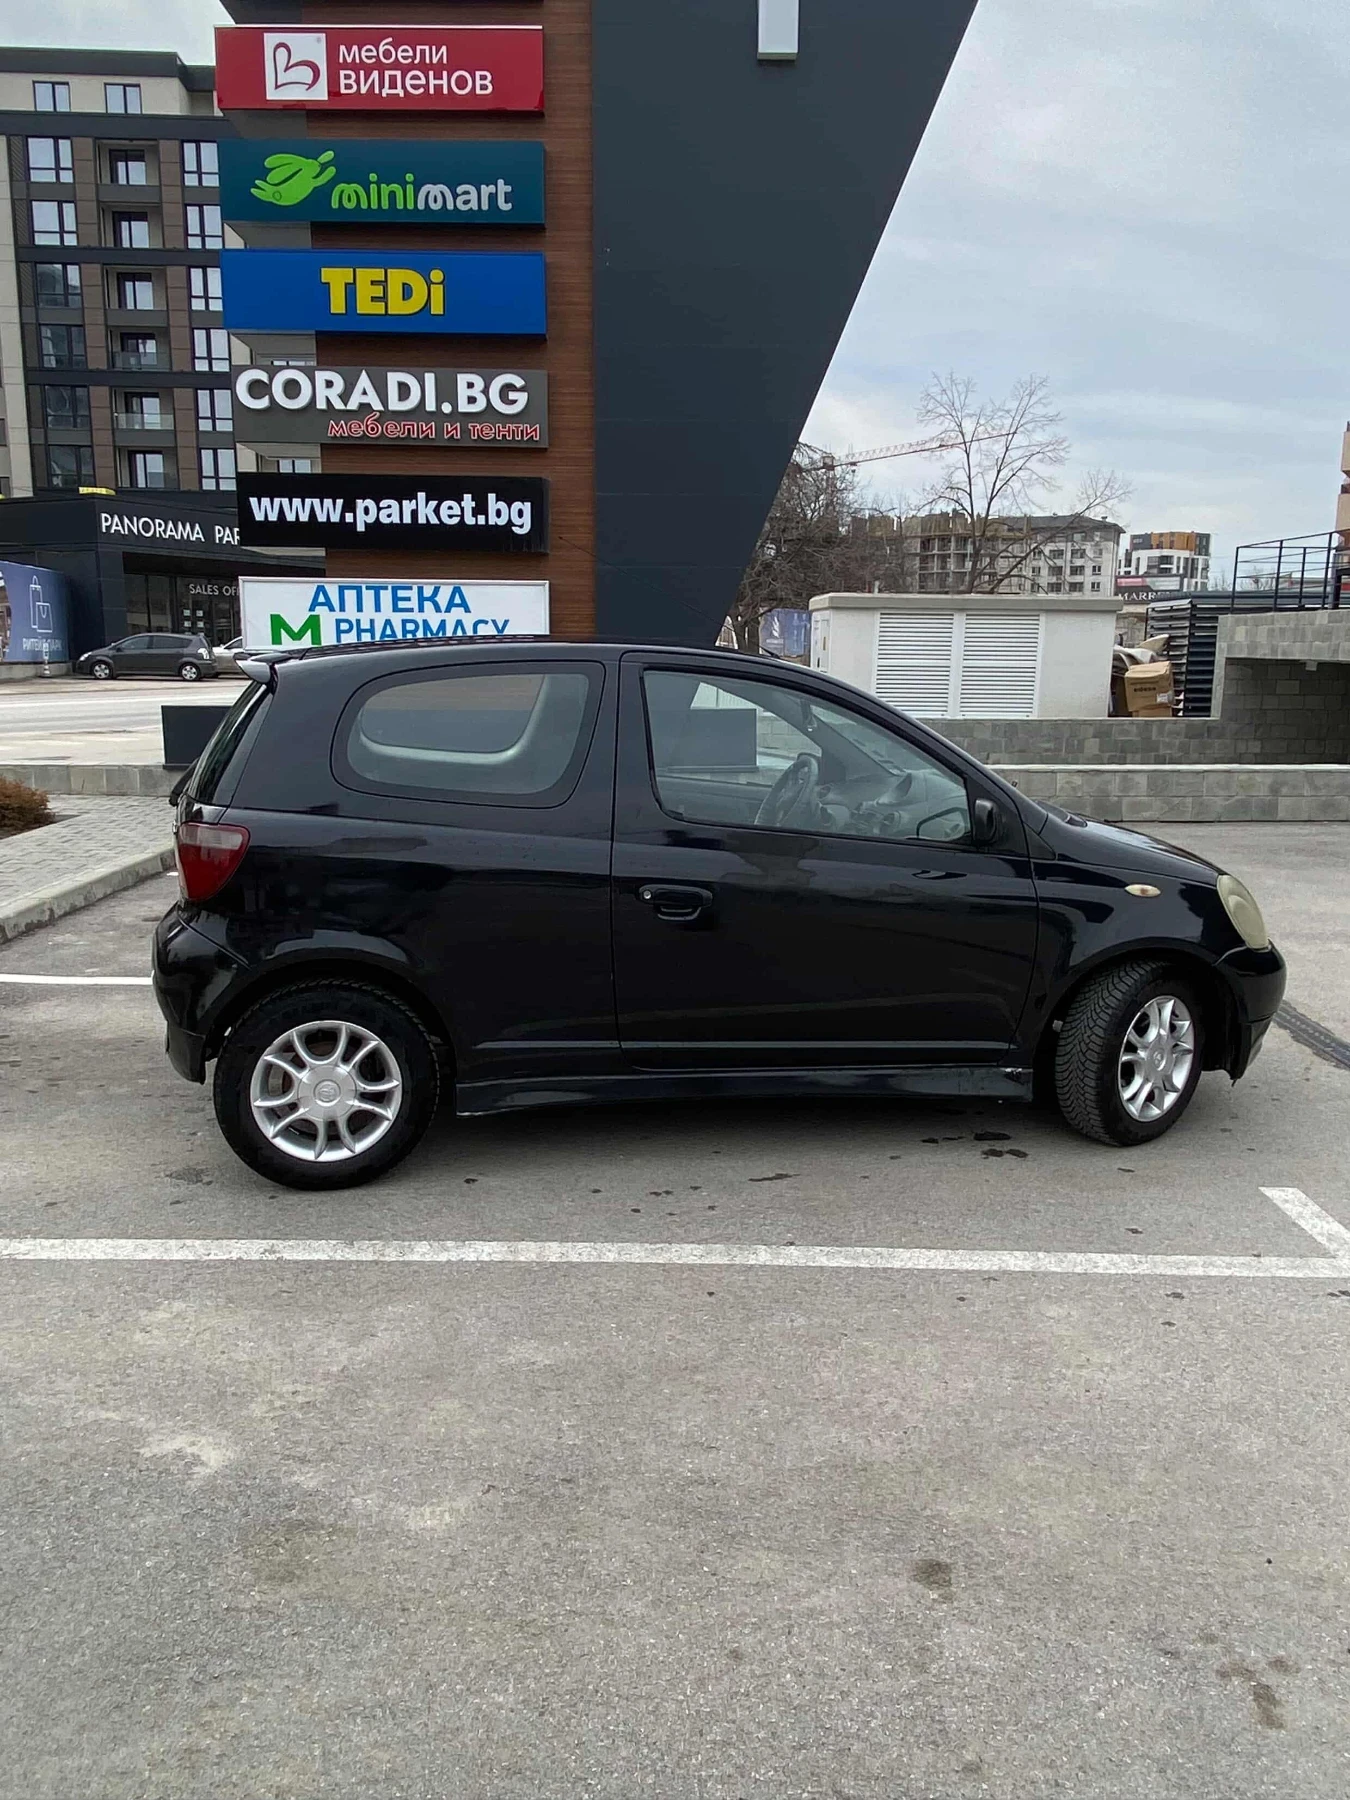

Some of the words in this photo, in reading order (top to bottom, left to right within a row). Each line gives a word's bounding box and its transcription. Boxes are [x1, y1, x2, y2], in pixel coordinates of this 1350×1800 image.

[339, 37, 448, 65] мебели
[331, 173, 513, 211] minimart
[320, 267, 445, 316] TEDi
[235, 368, 529, 415] CORADI.BG
[327, 411, 436, 438] мебели
[443, 422, 460, 438] и
[468, 421, 540, 441] тенти
[101, 513, 205, 542] PANORAMA
[215, 525, 240, 545] PAR
[249, 492, 532, 535] www.parket.bg
[189, 583, 219, 595] SALES
[222, 586, 240, 596] OF
[308, 584, 472, 613] АПТЕКА
